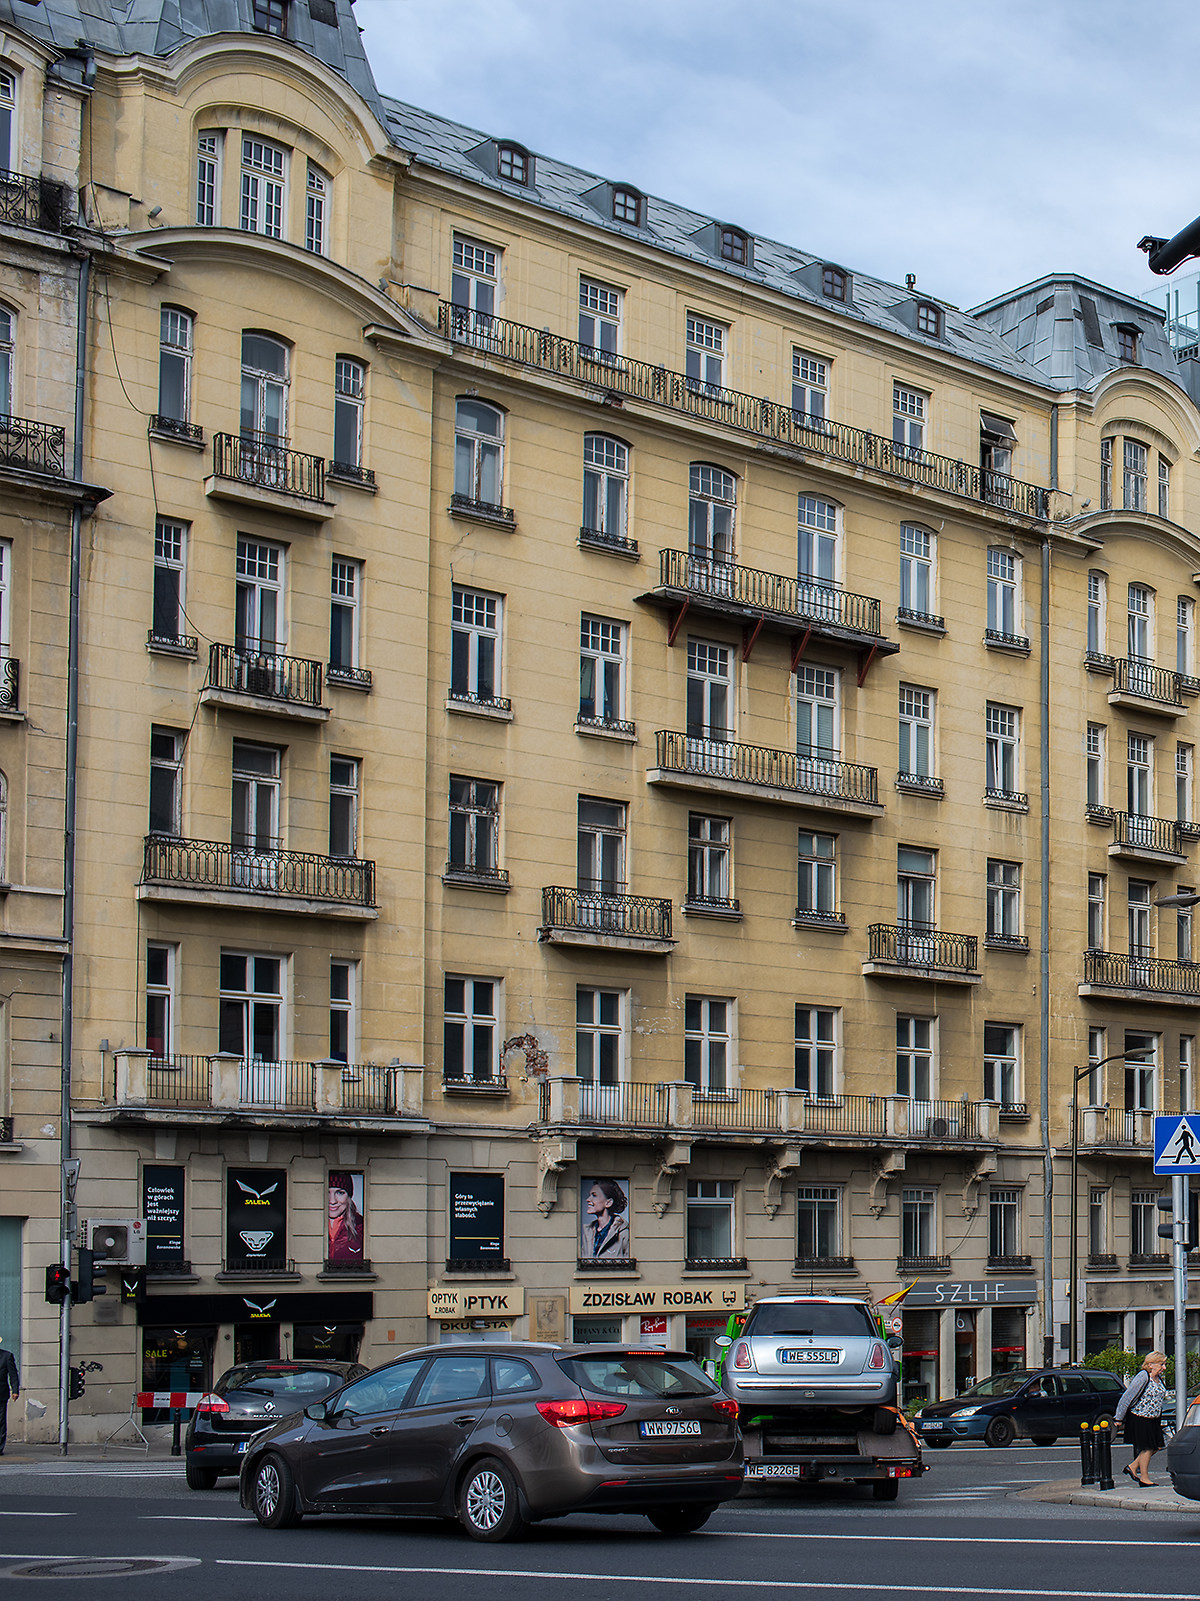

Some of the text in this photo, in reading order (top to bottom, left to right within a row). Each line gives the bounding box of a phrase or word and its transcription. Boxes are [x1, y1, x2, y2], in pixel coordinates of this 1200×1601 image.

[154, 1194, 174, 1202] górach
[454, 1193, 467, 1201] Góry
[147, 1208, 180, 1216] ważniejszy
[935, 1283, 1005, 1303] SZLIF
[431, 1292, 459, 1305] OPTYK
[582, 1290, 713, 1307] ZDZISŁAW ROBAK
[686, 1318, 727, 1328] CARRERA
[956, 1312, 965, 1329] 6
[145, 1349, 168, 1358] SALE
[789, 1351, 804, 1361] WE
[646, 1421, 701, 1435] WW 9756C
[749, 1465, 799, 1475] WE 822GE
